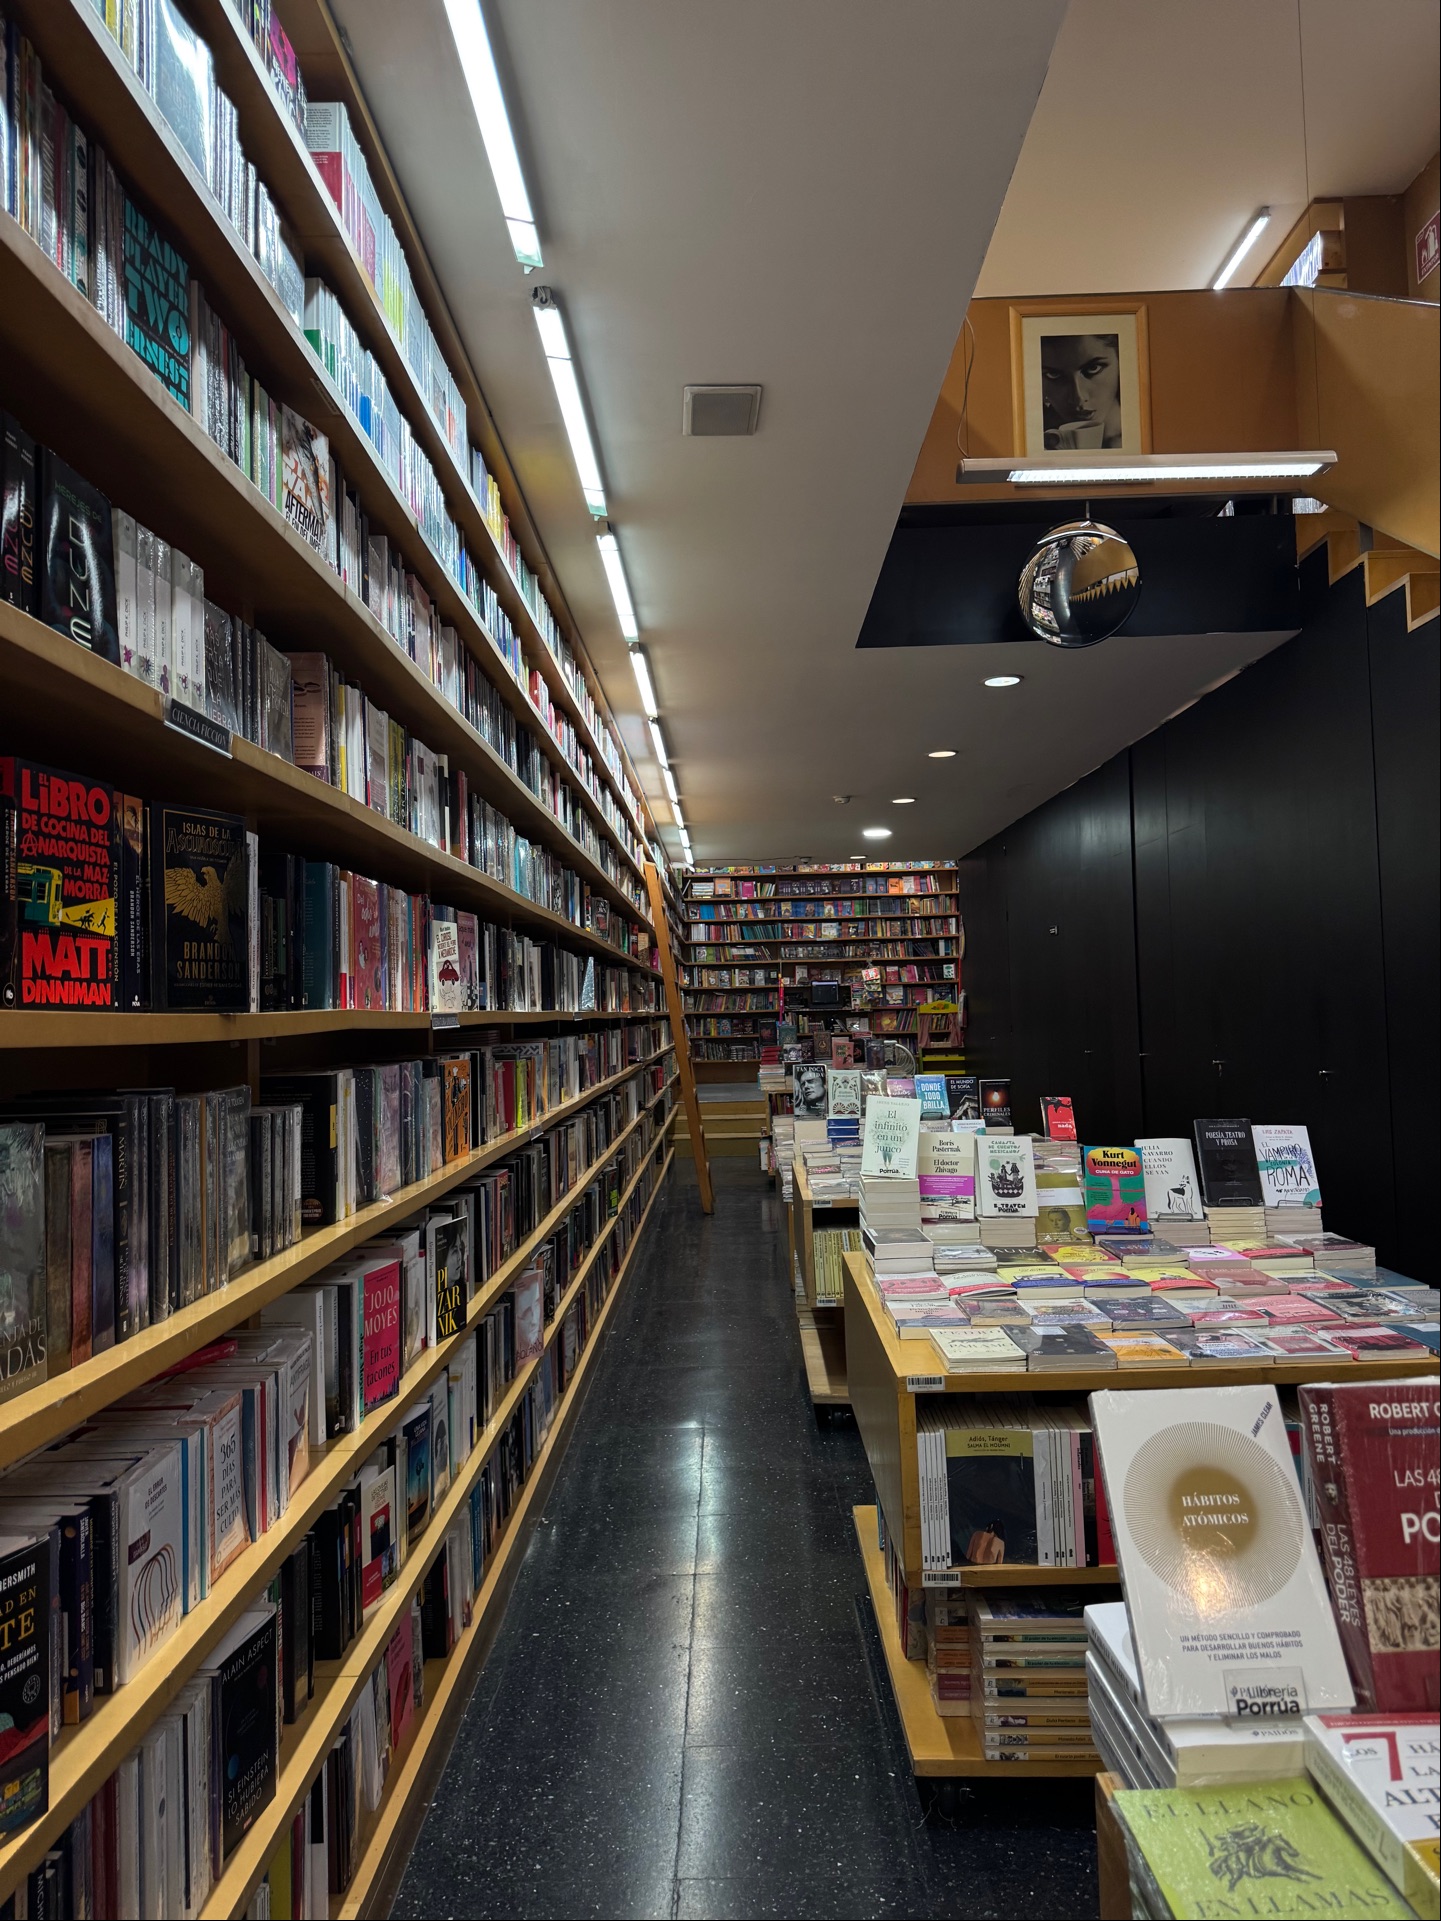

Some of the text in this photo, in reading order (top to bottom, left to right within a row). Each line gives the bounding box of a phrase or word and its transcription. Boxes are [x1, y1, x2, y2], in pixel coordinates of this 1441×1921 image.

[125, 262, 189, 356] TWO
[172, 707, 201, 734] CIENCIA
[38, 772, 49, 786] EL
[22, 812, 110, 846] DE COCINA DEL
[183, 822, 231, 840] ISLAS DE LA
[20, 830, 110, 866] ANARQUISTA
[64, 865, 72, 875] DE
[73, 866, 82, 877] LA
[63, 879, 110, 901] MORRA
[22, 930, 111, 979] MATT
[184, 941, 236, 961] BRANDON
[176, 960, 240, 980] SANDERSON
[22, 979, 111, 1006] DINNIMAN
[921, 1082, 941, 1092] DONDE
[924, 1091, 941, 1100] TODO
[887, 1110, 897, 1119] El
[923, 1099, 945, 1110] BRILLA
[874, 1120, 908, 1132] infinito
[874, 1143, 902, 1154] junco
[890, 1134, 902, 1142] un
[932, 1145, 961, 1153] Pasternak
[1220, 1138, 1238, 1146] PROSA
[1091, 1158, 1137, 1169] Vonnegut
[1102, 1150, 1124, 1159] Kurt
[1259, 1143, 1302, 1163] VAMPIRO
[934, 1166, 958, 1174] Zhivago
[1266, 1165, 1311, 1187] ROMA
[437, 1266, 448, 1293] PI
[369, 1284, 394, 1313] JOJO
[437, 1285, 461, 1316] ZAR
[364, 1305, 398, 1338] MOYES
[370, 1343, 392, 1366] En tus
[366, 1361, 395, 1388] tacones
[1250, 1401, 1273, 1438] JAMES CLEAR
[1368, 1402, 1430, 1419] ROBERT
[988, 1435, 1008, 1443] Tánger
[1309, 1403, 1325, 1463] GREENE
[1319, 1403, 1336, 1464] ROBERT
[1388, 1426, 1436, 1437] Una producción
[219, 1432, 237, 1465] 365
[221, 1460, 236, 1482] DÍAS
[1394, 1469, 1425, 1487] LAS
[153, 1476, 164, 1494] ERROR
[220, 1475, 237, 1500] PARA
[1181, 1492, 1240, 1508] HÁBITOS
[216, 1502, 229, 1521] SER
[220, 1506, 240, 1534] CULTO
[1181, 1511, 1249, 1527] ATÓMICOS
[0, 1562, 36, 1592] ERSMITH
[1326, 1523, 1350, 1623] DEL PODER
[1337, 1523, 1361, 1627] LAS 48 LEYES
[19, 1585, 37, 1607] EN
[1179, 1630, 1301, 1643] UN MÉTODO SENCILLO Y COMPROBADO
[1200, 1642, 1247, 1651] DESARROLLAR
[1248, 1641, 1275, 1650] BUENOS
[1275, 1639, 1304, 1648] HÁBITOS
[3, 1651, 39, 1682] PENSADO BIEN?
[222, 1628, 274, 1685] ALAIN ASPECT
[1207, 1650, 1283, 1661] Y ELIMINAR LOS MALOS
[1235, 1697, 1300, 1716] Porrúa
[1341, 1731, 1403, 1782] 7
[228, 1750, 270, 1805] SI EINSTEIN
[228, 1767, 269, 1819] LO HUBIERA
[235, 1785, 263, 1825] SABIDO
[36, 1873, 45, 1920] MICHI
